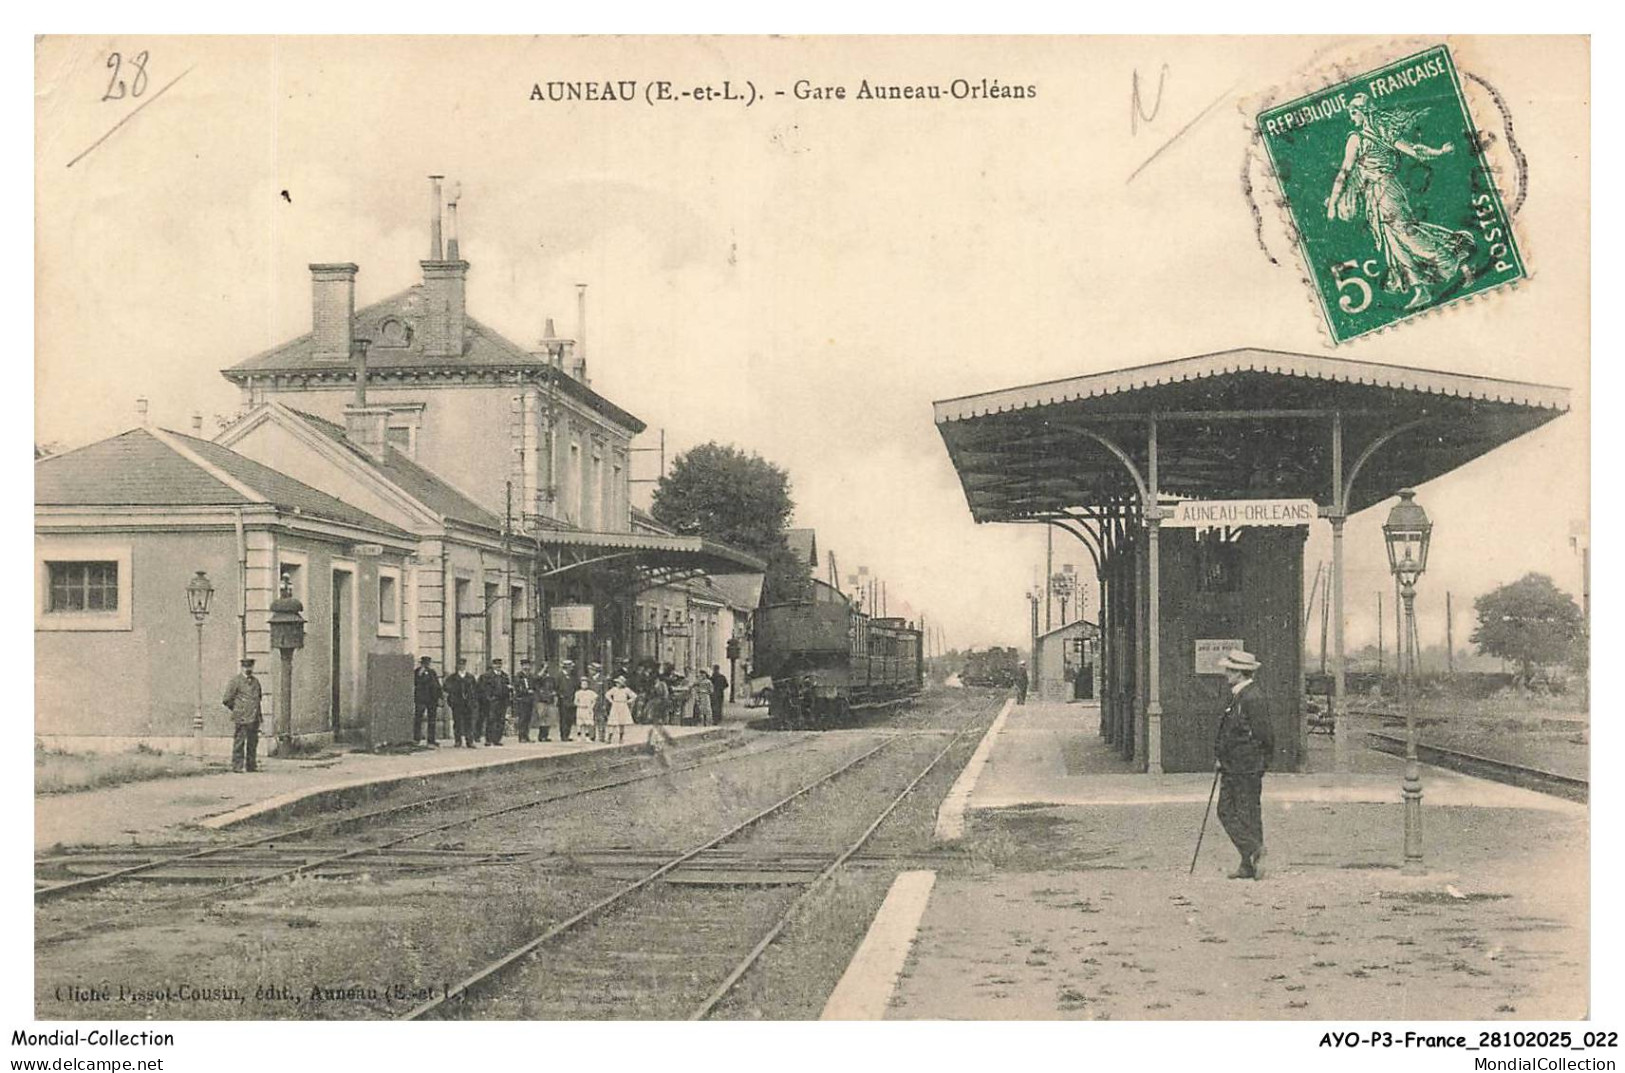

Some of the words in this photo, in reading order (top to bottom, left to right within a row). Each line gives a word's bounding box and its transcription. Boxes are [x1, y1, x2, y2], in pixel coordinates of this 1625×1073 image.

[102, 50, 149, 101] 28
[530, 80, 637, 101] AUNEAU
[645, 81, 764, 107] (E.-et-L.).
[793, 80, 846, 100] Gare
[856, 78, 1036, 100] Auneau-Orléans
[1266, 93, 1350, 136] REPUBLIQUE
[1368, 57, 1446, 99] FRANÇAISE
[1472, 194, 1513, 272] POSTES
[310, 984, 377, 1001] Auneau
